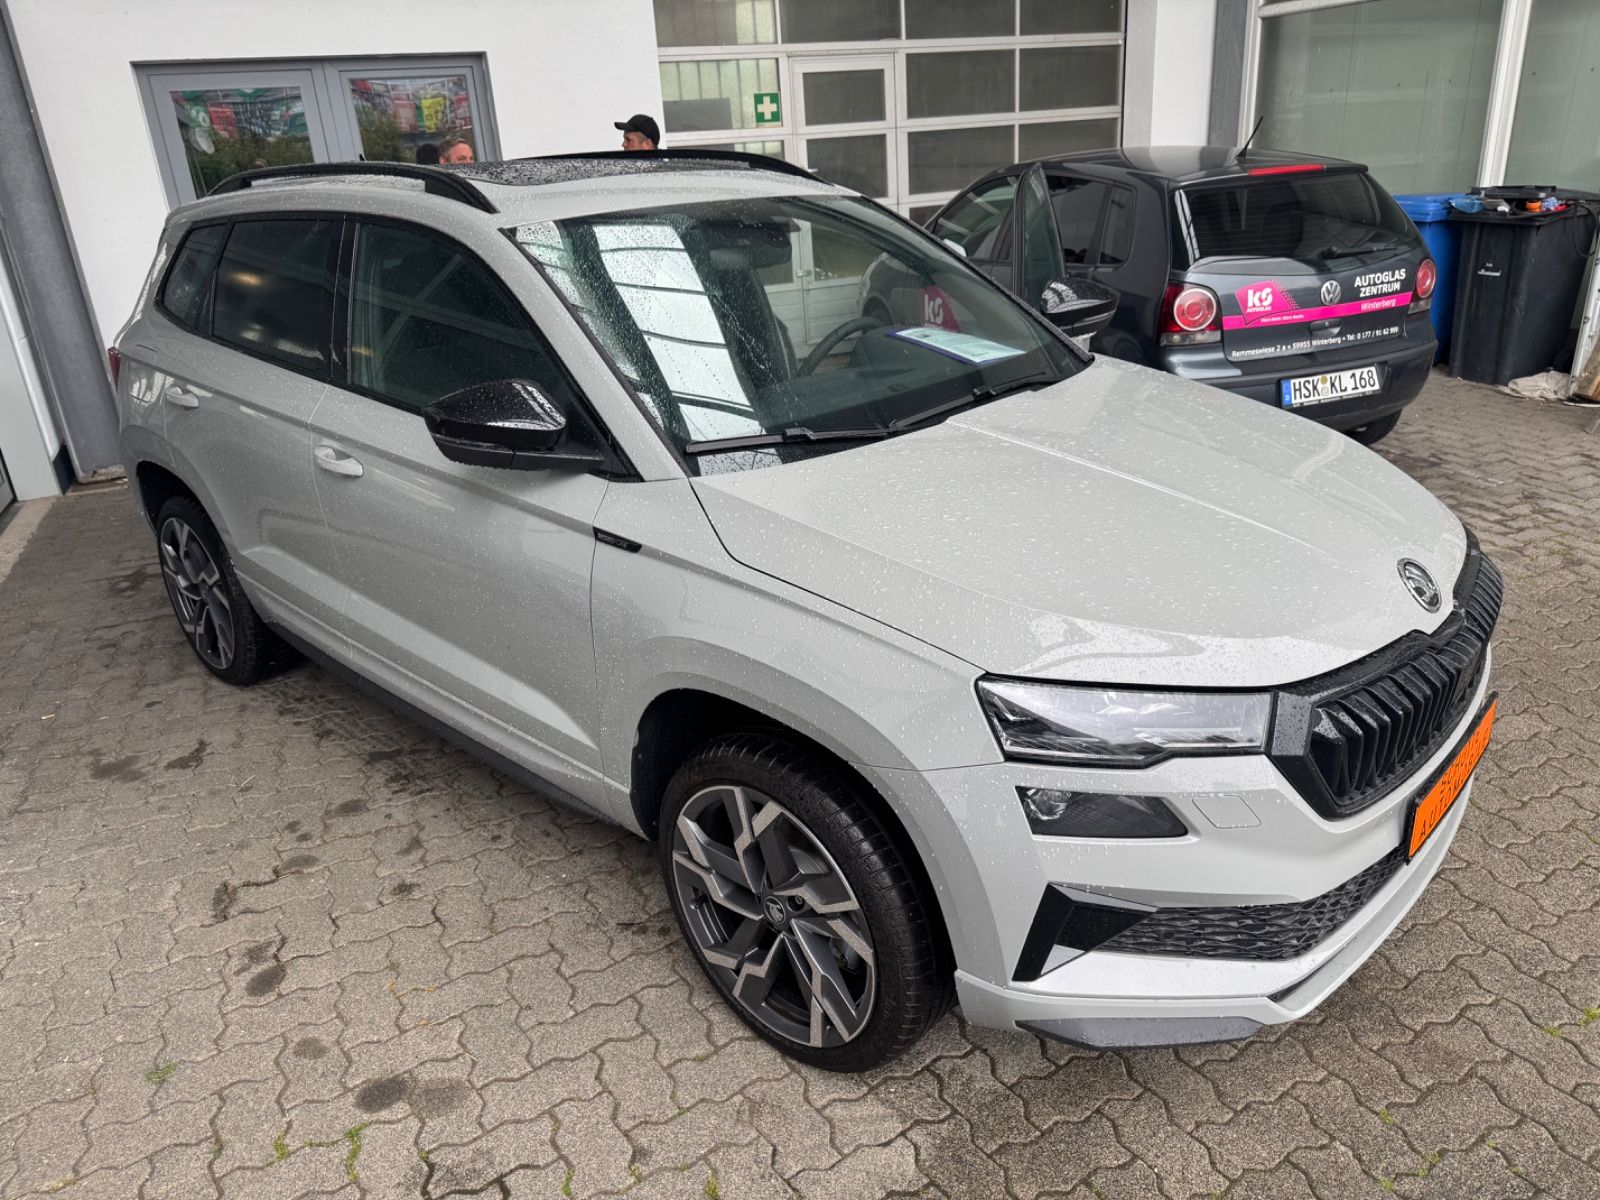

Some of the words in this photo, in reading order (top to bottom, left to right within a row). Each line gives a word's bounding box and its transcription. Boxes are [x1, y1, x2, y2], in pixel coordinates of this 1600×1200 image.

[1354, 268, 1406, 288] AUTOGLAS
[1359, 281, 1401, 297] ZENTRUM
[1360, 299, 1397, 311] Winterberg
[1276, 344, 1281, 353] 2
[1311, 337, 1342, 346] Winterberg
[1293, 378, 1321, 400] HSK
[1329, 374, 1348, 394] KL
[1349, 369, 1376, 391] 168
